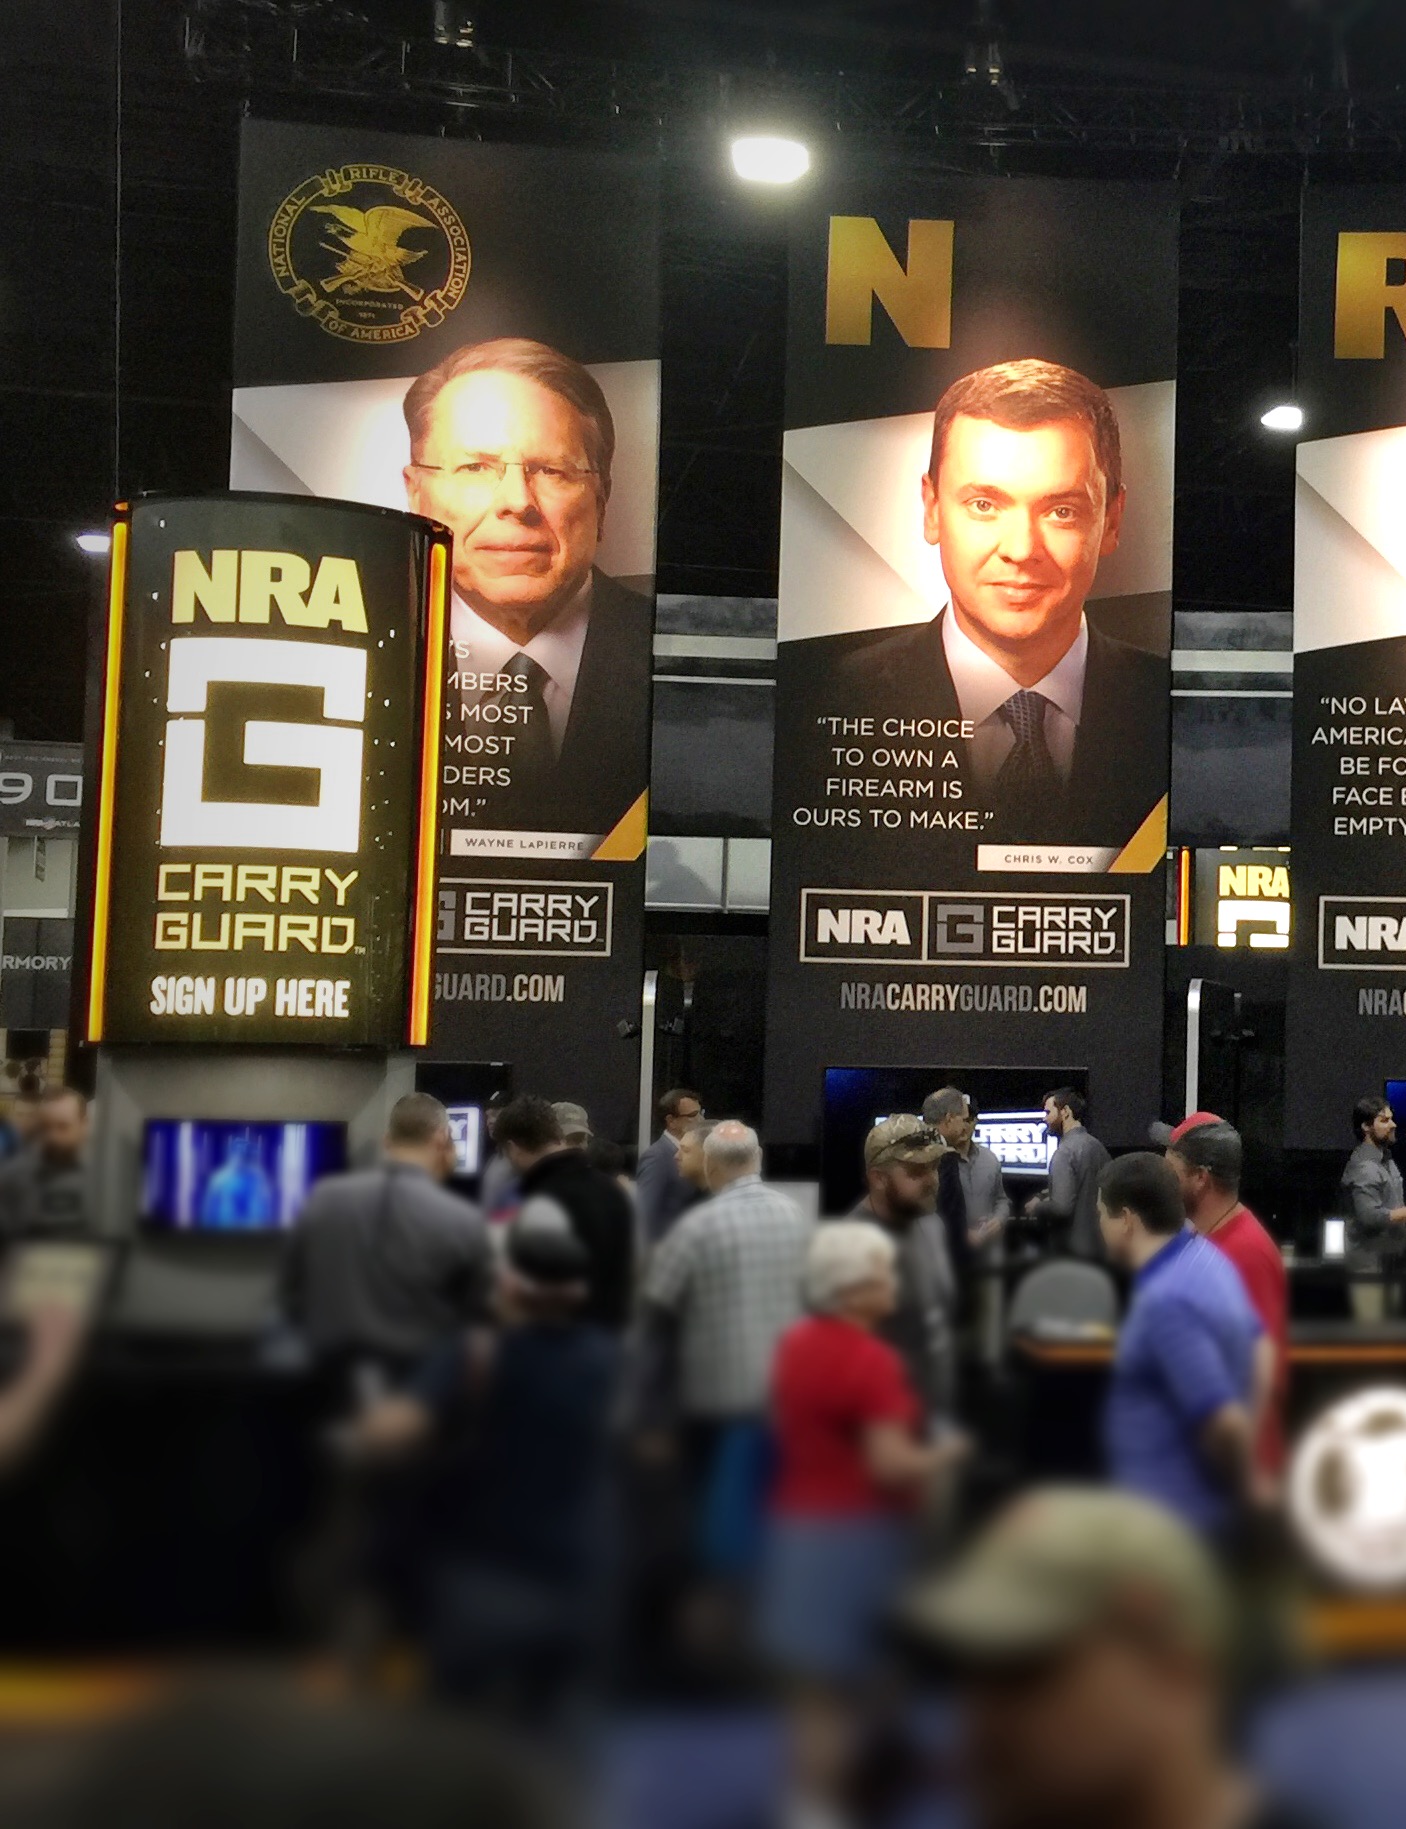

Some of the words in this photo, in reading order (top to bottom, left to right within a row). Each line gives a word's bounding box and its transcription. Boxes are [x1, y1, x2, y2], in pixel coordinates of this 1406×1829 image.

[272, 195, 306, 277] NATIONAL
[351, 167, 400, 183] RIFLE
[427, 198, 467, 298] ASSOCIATION
[825, 215, 955, 349] N
[328, 320, 348, 335] OF
[350, 322, 416, 341] AMERICA
[171, 548, 369, 634] NRA
[460, 703, 534, 725] MOST
[882, 718, 975, 739] CHOICE
[444, 734, 516, 755] MOST
[831, 748, 865, 768] TO
[872, 748, 934, 769] OWN
[941, 749, 959, 769] A
[1340, 757, 1370, 777] BE
[443, 765, 511, 787] DERS
[826, 778, 935, 798] FIREARM
[942, 779, 963, 799] IS
[1332, 787, 1393, 807] FACE
[792, 807, 861, 829] OURS
[868, 809, 902, 829] TO
[464, 837, 514, 849] WAYNE
[1004, 853, 1041, 865] CHRIS
[1047, 854, 1064, 865] W.
[1067, 854, 1094, 866] COX
[158, 864, 360, 906] CARRY
[1218, 864, 1290, 899] NRA
[464, 891, 600, 918] CARRY
[463, 917, 598, 943] GUARD
[816, 907, 911, 946] NRA
[991, 905, 1118, 930] CARRY
[155, 911, 358, 955] GUARD
[991, 930, 1117, 955] GUARD
[150, 975, 215, 1016] SIGN
[223, 975, 266, 1017] UP
[275, 978, 350, 1019] HERE
[840, 981, 1088, 1014] NRACARRYGUARD.COM
